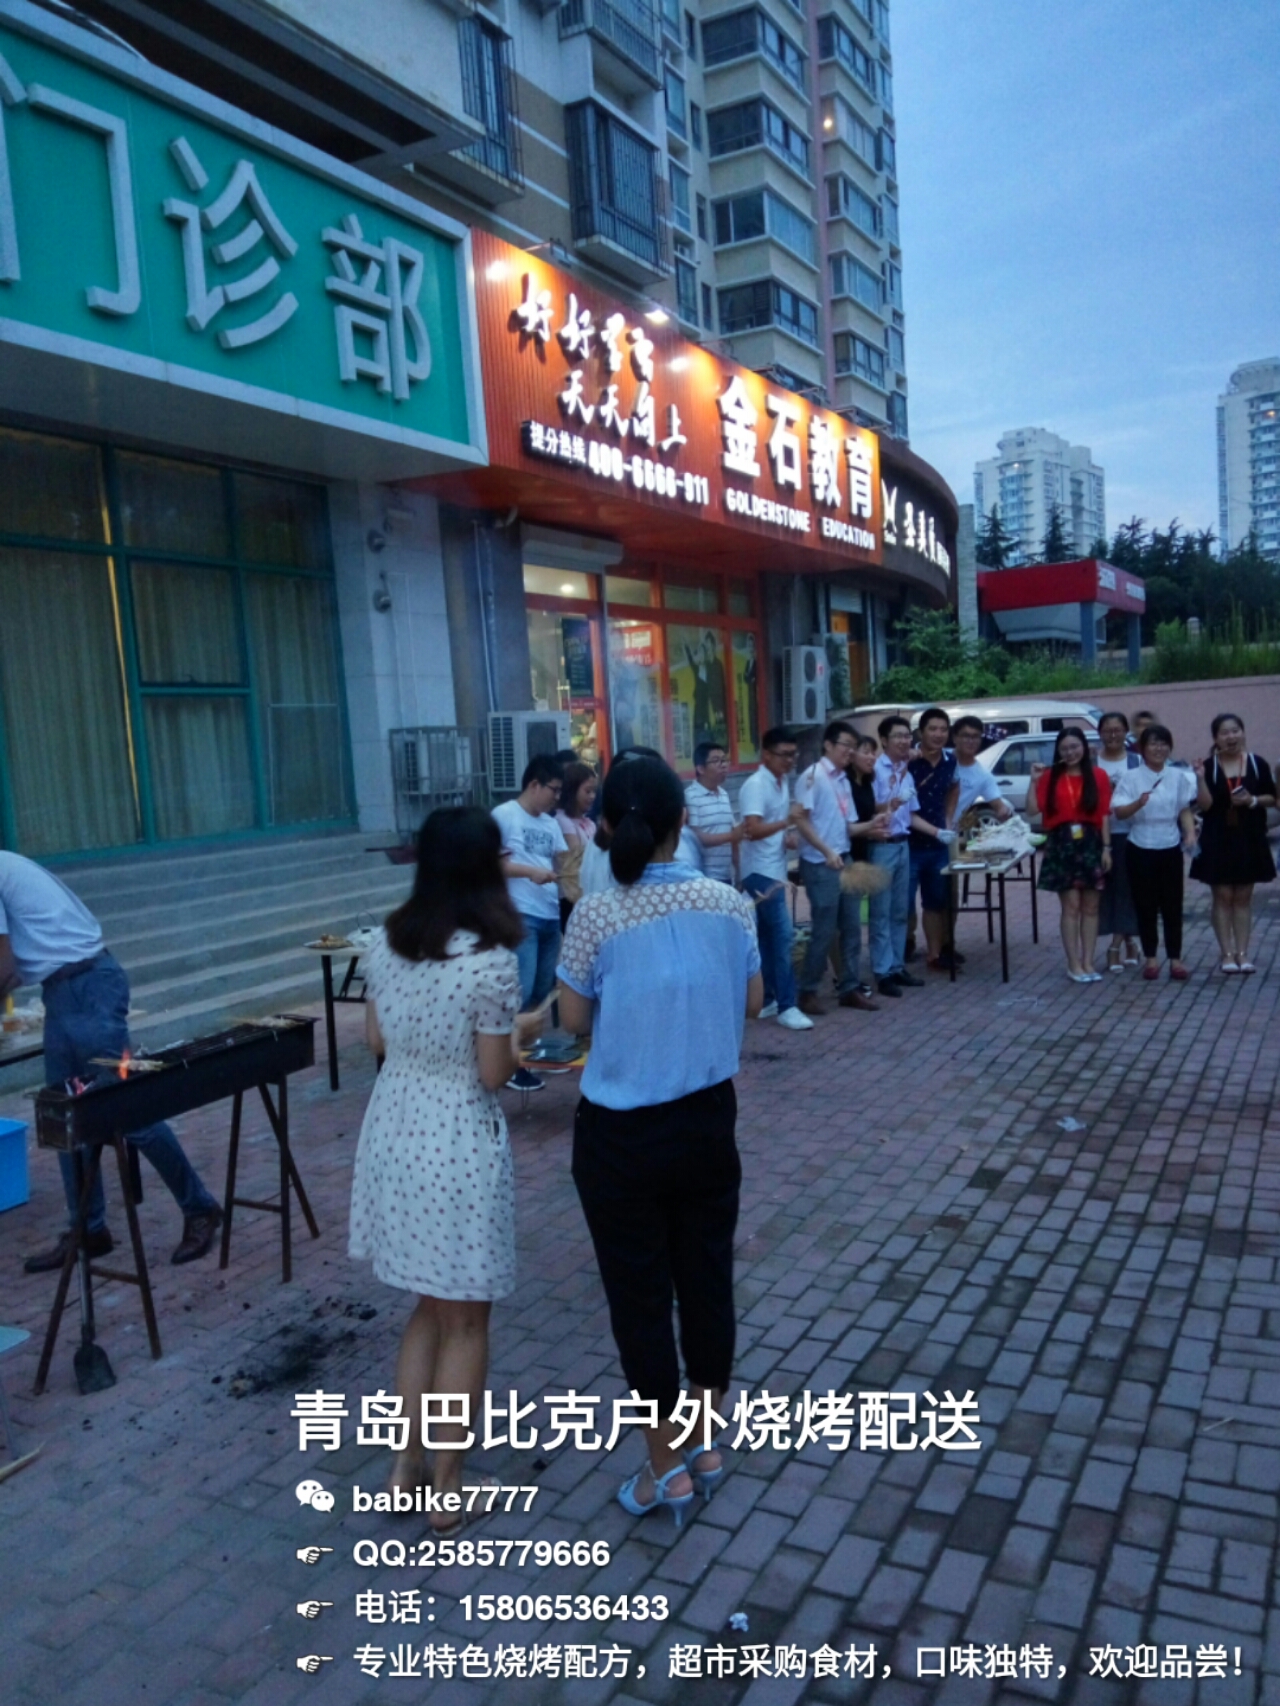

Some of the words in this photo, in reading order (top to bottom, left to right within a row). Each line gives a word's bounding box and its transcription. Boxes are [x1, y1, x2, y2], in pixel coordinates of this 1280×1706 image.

[0, 54, 433, 401] 门诊部
[561, 370, 687, 452] 天天向上
[719, 375, 873, 519] 金石教育
[725, 486, 811, 533] GOLDENSTONE
[822, 516, 876, 551] EDUCATION
